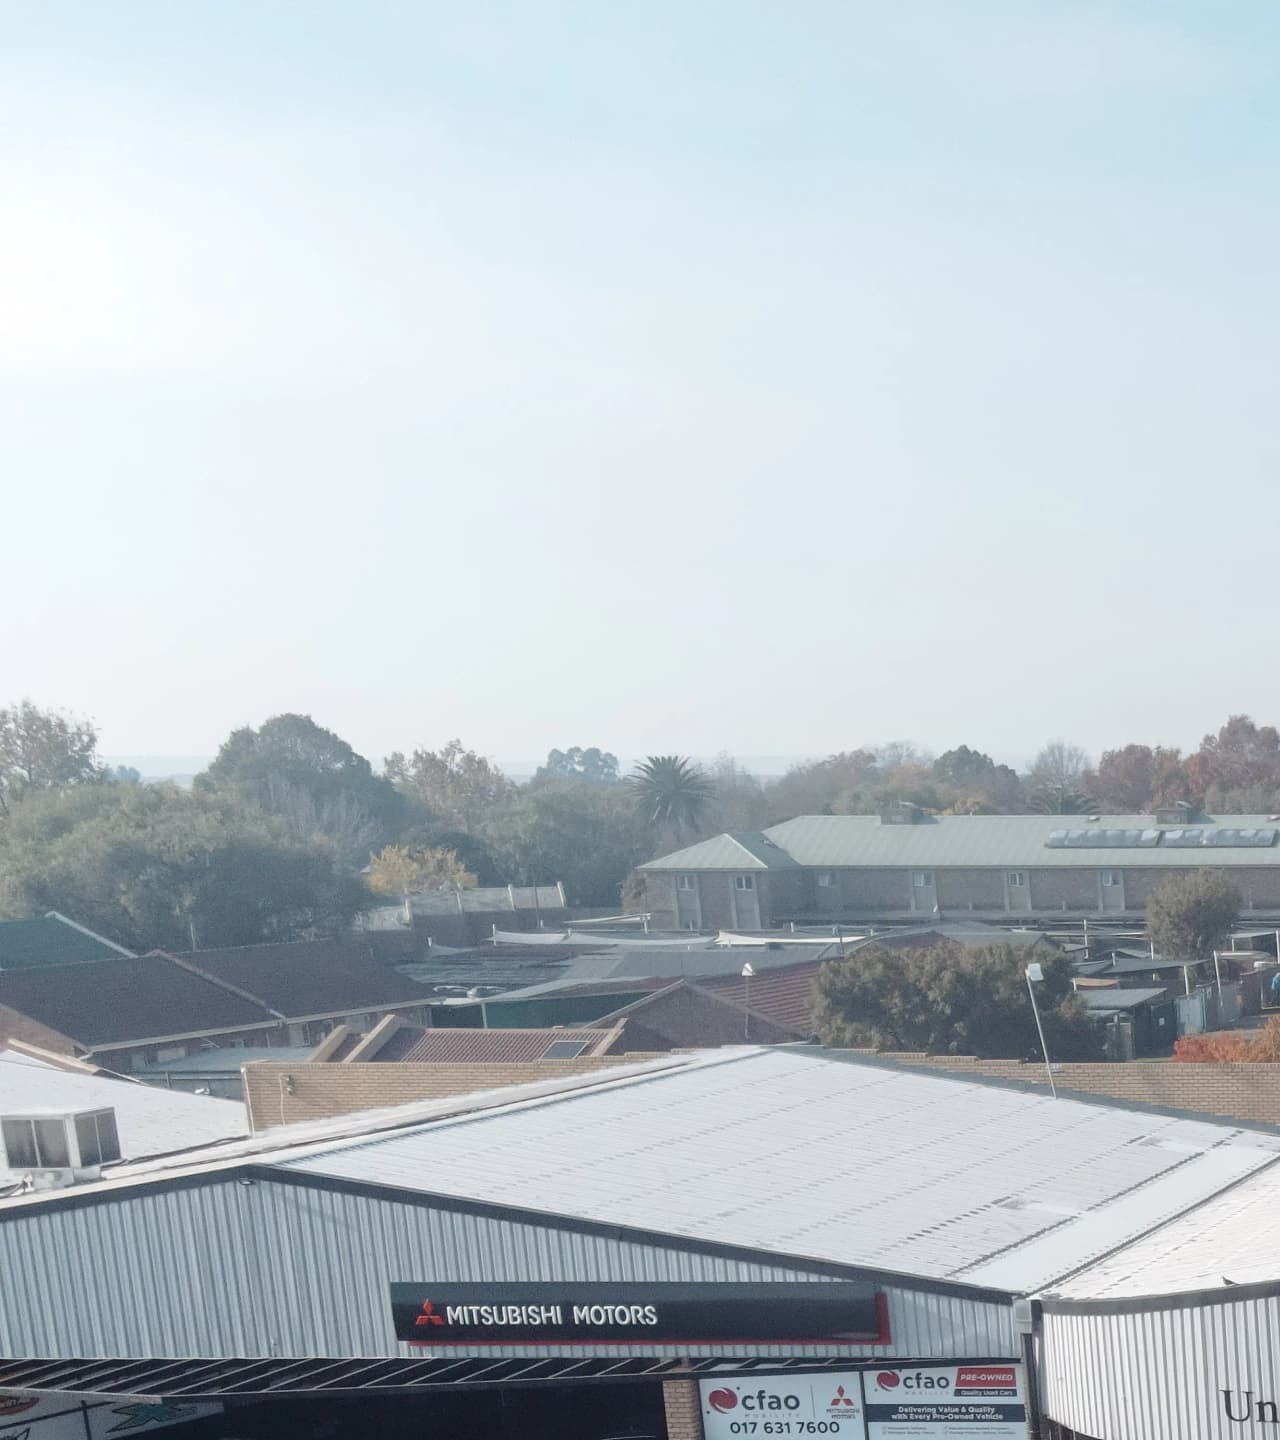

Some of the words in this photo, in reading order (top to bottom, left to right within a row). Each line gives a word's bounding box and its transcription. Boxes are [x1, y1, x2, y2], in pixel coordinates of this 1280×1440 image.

[447, 1305, 563, 1325] MITSUBISHI
[573, 1305, 658, 1325] MOTORS
[903, 1372, 950, 1389] cfao
[742, 1390, 800, 1410] cfao
[898, 1406, 936, 1414] Delivering
[968, 1406, 995, 1414] Quality
[730, 1422, 757, 1434] 017
[764, 1422, 791, 1434] 631
[797, 1421, 840, 1434] 7600
